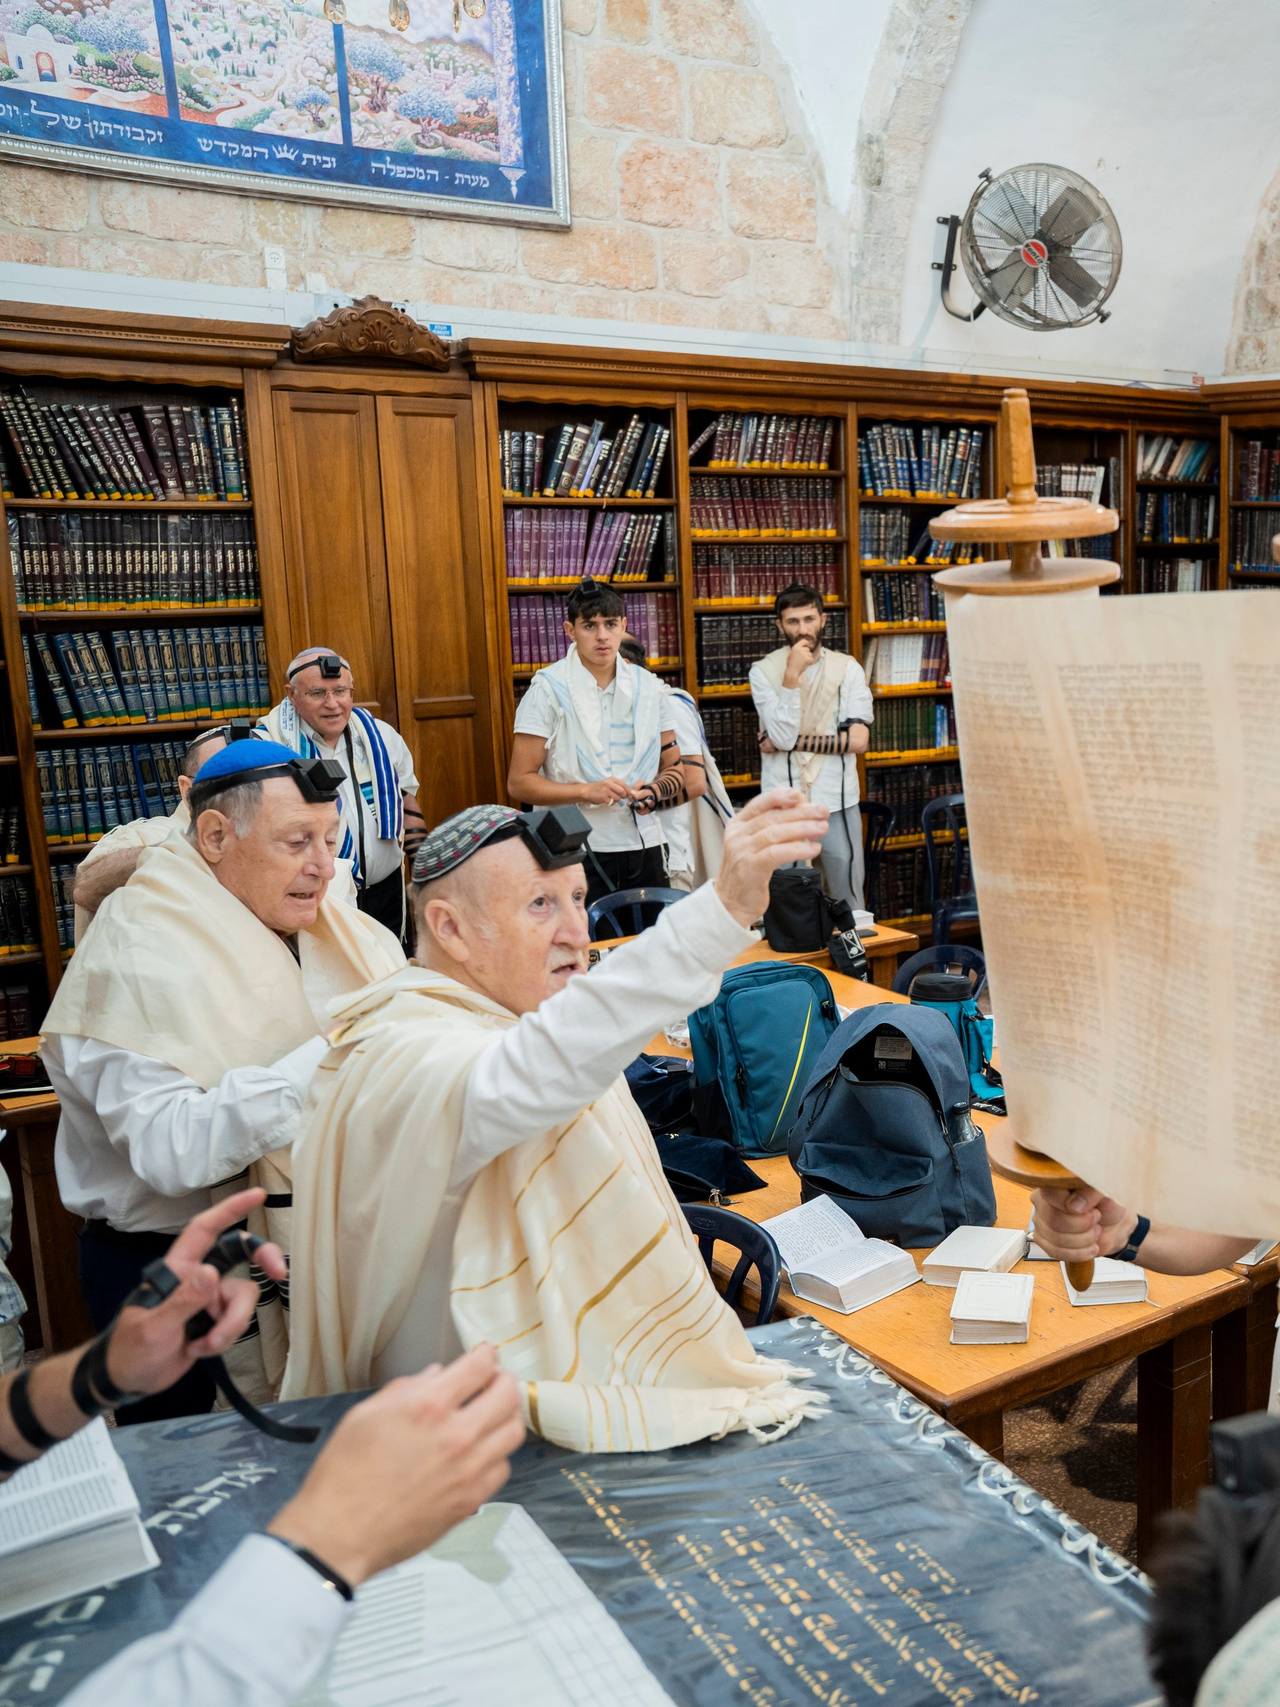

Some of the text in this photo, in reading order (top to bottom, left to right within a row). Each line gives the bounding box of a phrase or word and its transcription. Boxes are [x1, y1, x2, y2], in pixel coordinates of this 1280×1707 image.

[30, 99, 82, 130] של
[93, 119, 164, 146] וקבורתו
[197, 136, 337, 171] ובית המקדש
[371, 158, 440, 184] המכפלה
[454, 173, 490, 189] מערת
[1024, 242, 1045, 264] Venta
[796, 1664, 857, 1707] ישרא
